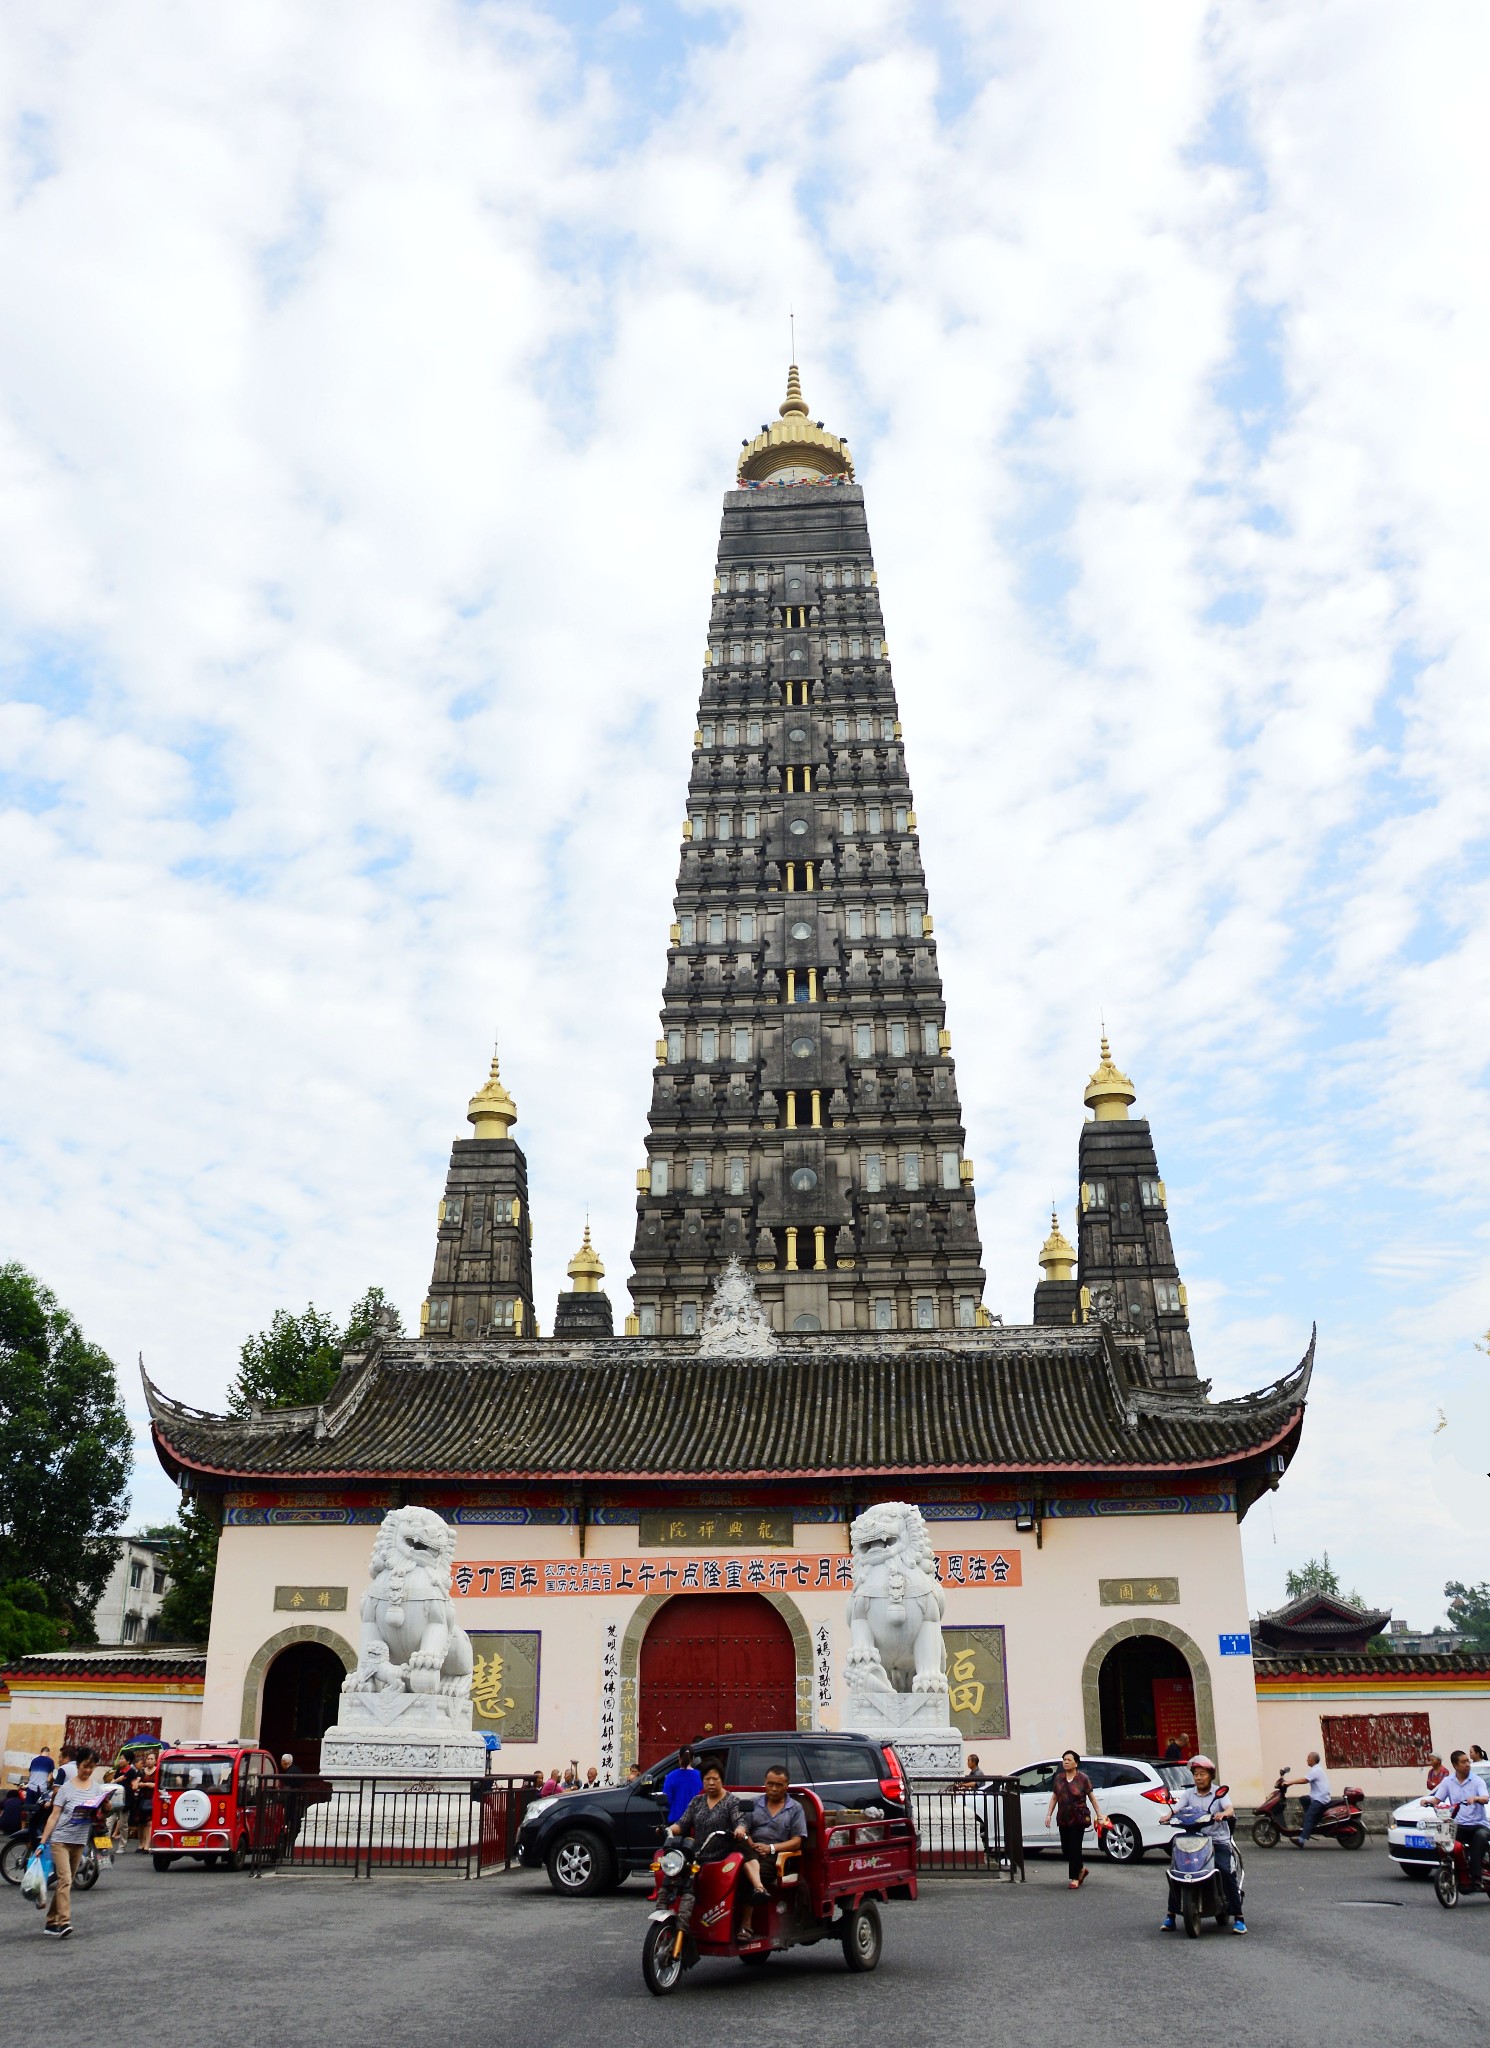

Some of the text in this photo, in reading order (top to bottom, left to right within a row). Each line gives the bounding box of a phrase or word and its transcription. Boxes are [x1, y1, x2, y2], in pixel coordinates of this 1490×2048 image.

[544, 1563, 612, 1577] 农历七月十三
[544, 1578, 612, 1593] 国历九月三日
[1231, 1640, 1237, 1651] 1
[470, 1652, 515, 1719] 慧
